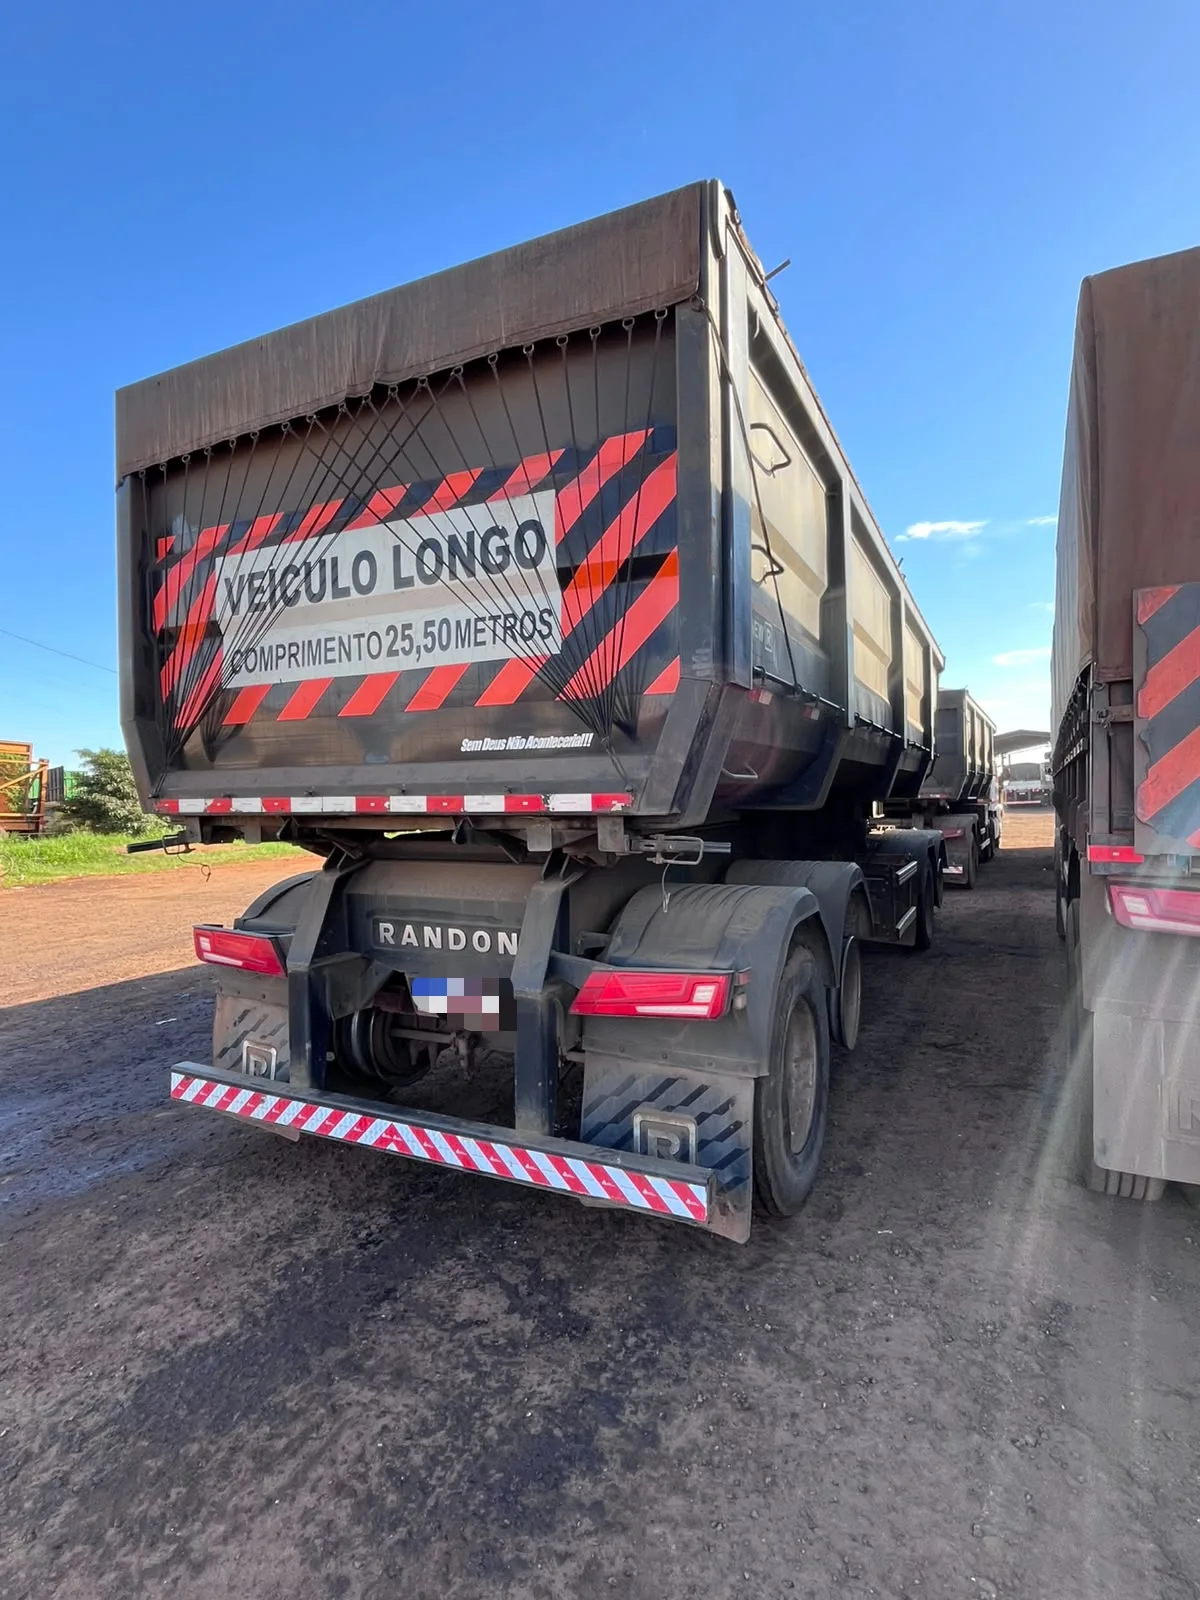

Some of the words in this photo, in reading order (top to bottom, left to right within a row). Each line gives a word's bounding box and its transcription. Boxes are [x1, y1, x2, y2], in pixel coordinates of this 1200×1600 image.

[393, 519, 546, 590] LONGO
[231, 631, 382, 674] COMPRIMENTO
[386, 617, 451, 662] 25,50
[455, 608, 553, 649] METROS
[461, 739, 482, 752] Sem
[482, 737, 506, 750] Deus
[506, 735, 526, 749] Não
[379, 923, 518, 955] RANDON
